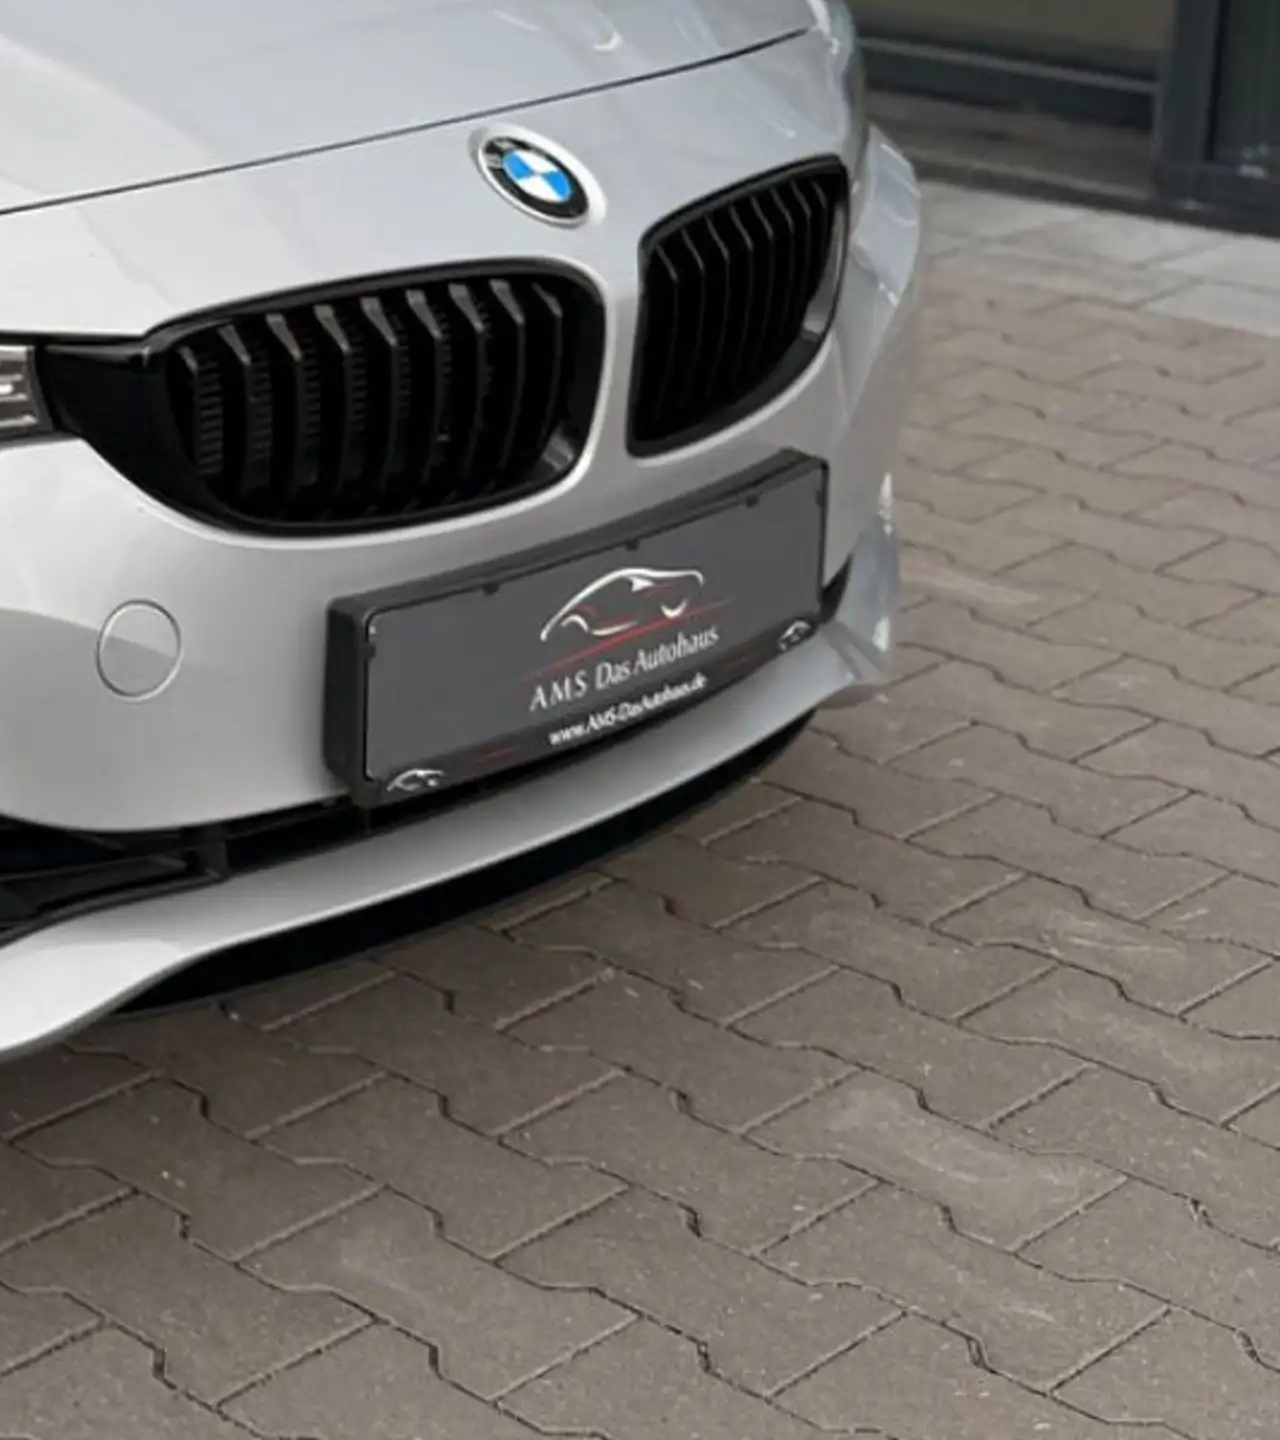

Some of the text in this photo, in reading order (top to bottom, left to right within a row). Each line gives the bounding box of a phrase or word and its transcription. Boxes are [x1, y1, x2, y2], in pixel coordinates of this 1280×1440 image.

[529, 625, 719, 712] AMS Das Autohaus
